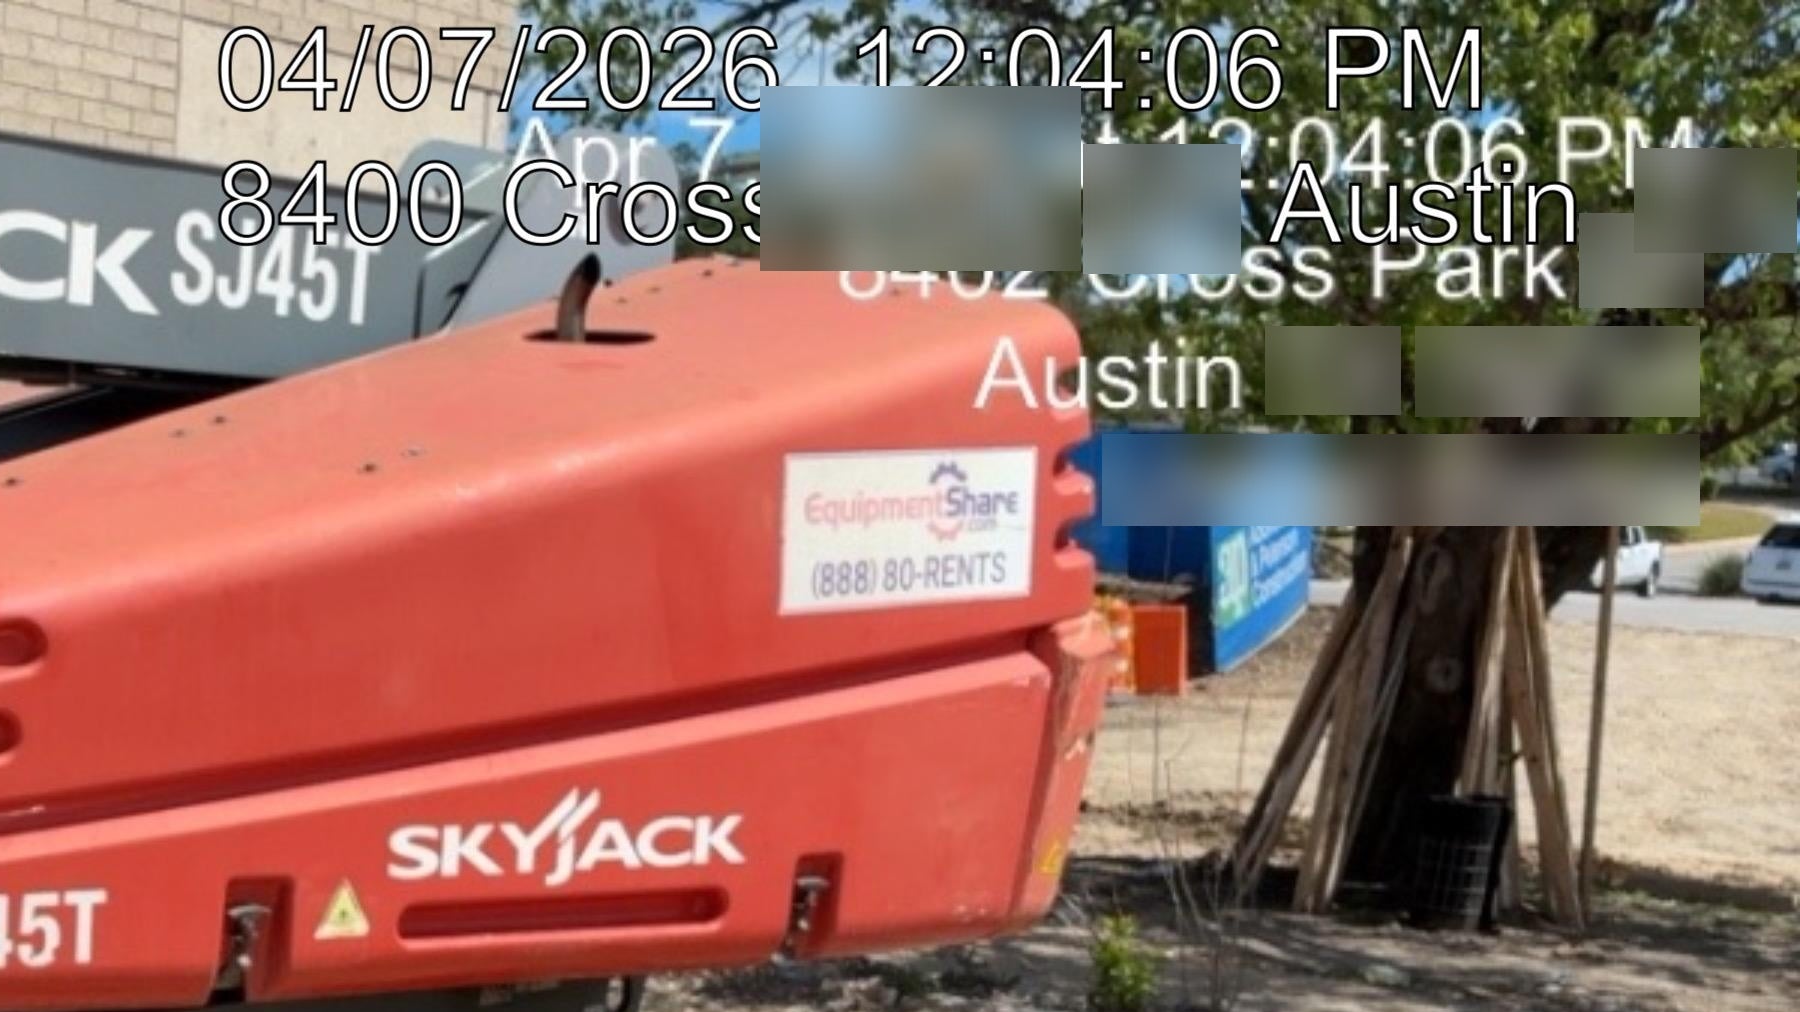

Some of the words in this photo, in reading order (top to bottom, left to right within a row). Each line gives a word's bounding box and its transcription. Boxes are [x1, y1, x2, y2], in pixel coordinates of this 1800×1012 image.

[169, 208, 383, 326] SJ45T
[804, 486, 1019, 530] EquipmentShare
[811, 559, 877, 599] (888)
[883, 551, 1008, 593] 80-RENTS
[386, 786, 746, 887] SKYJACK
